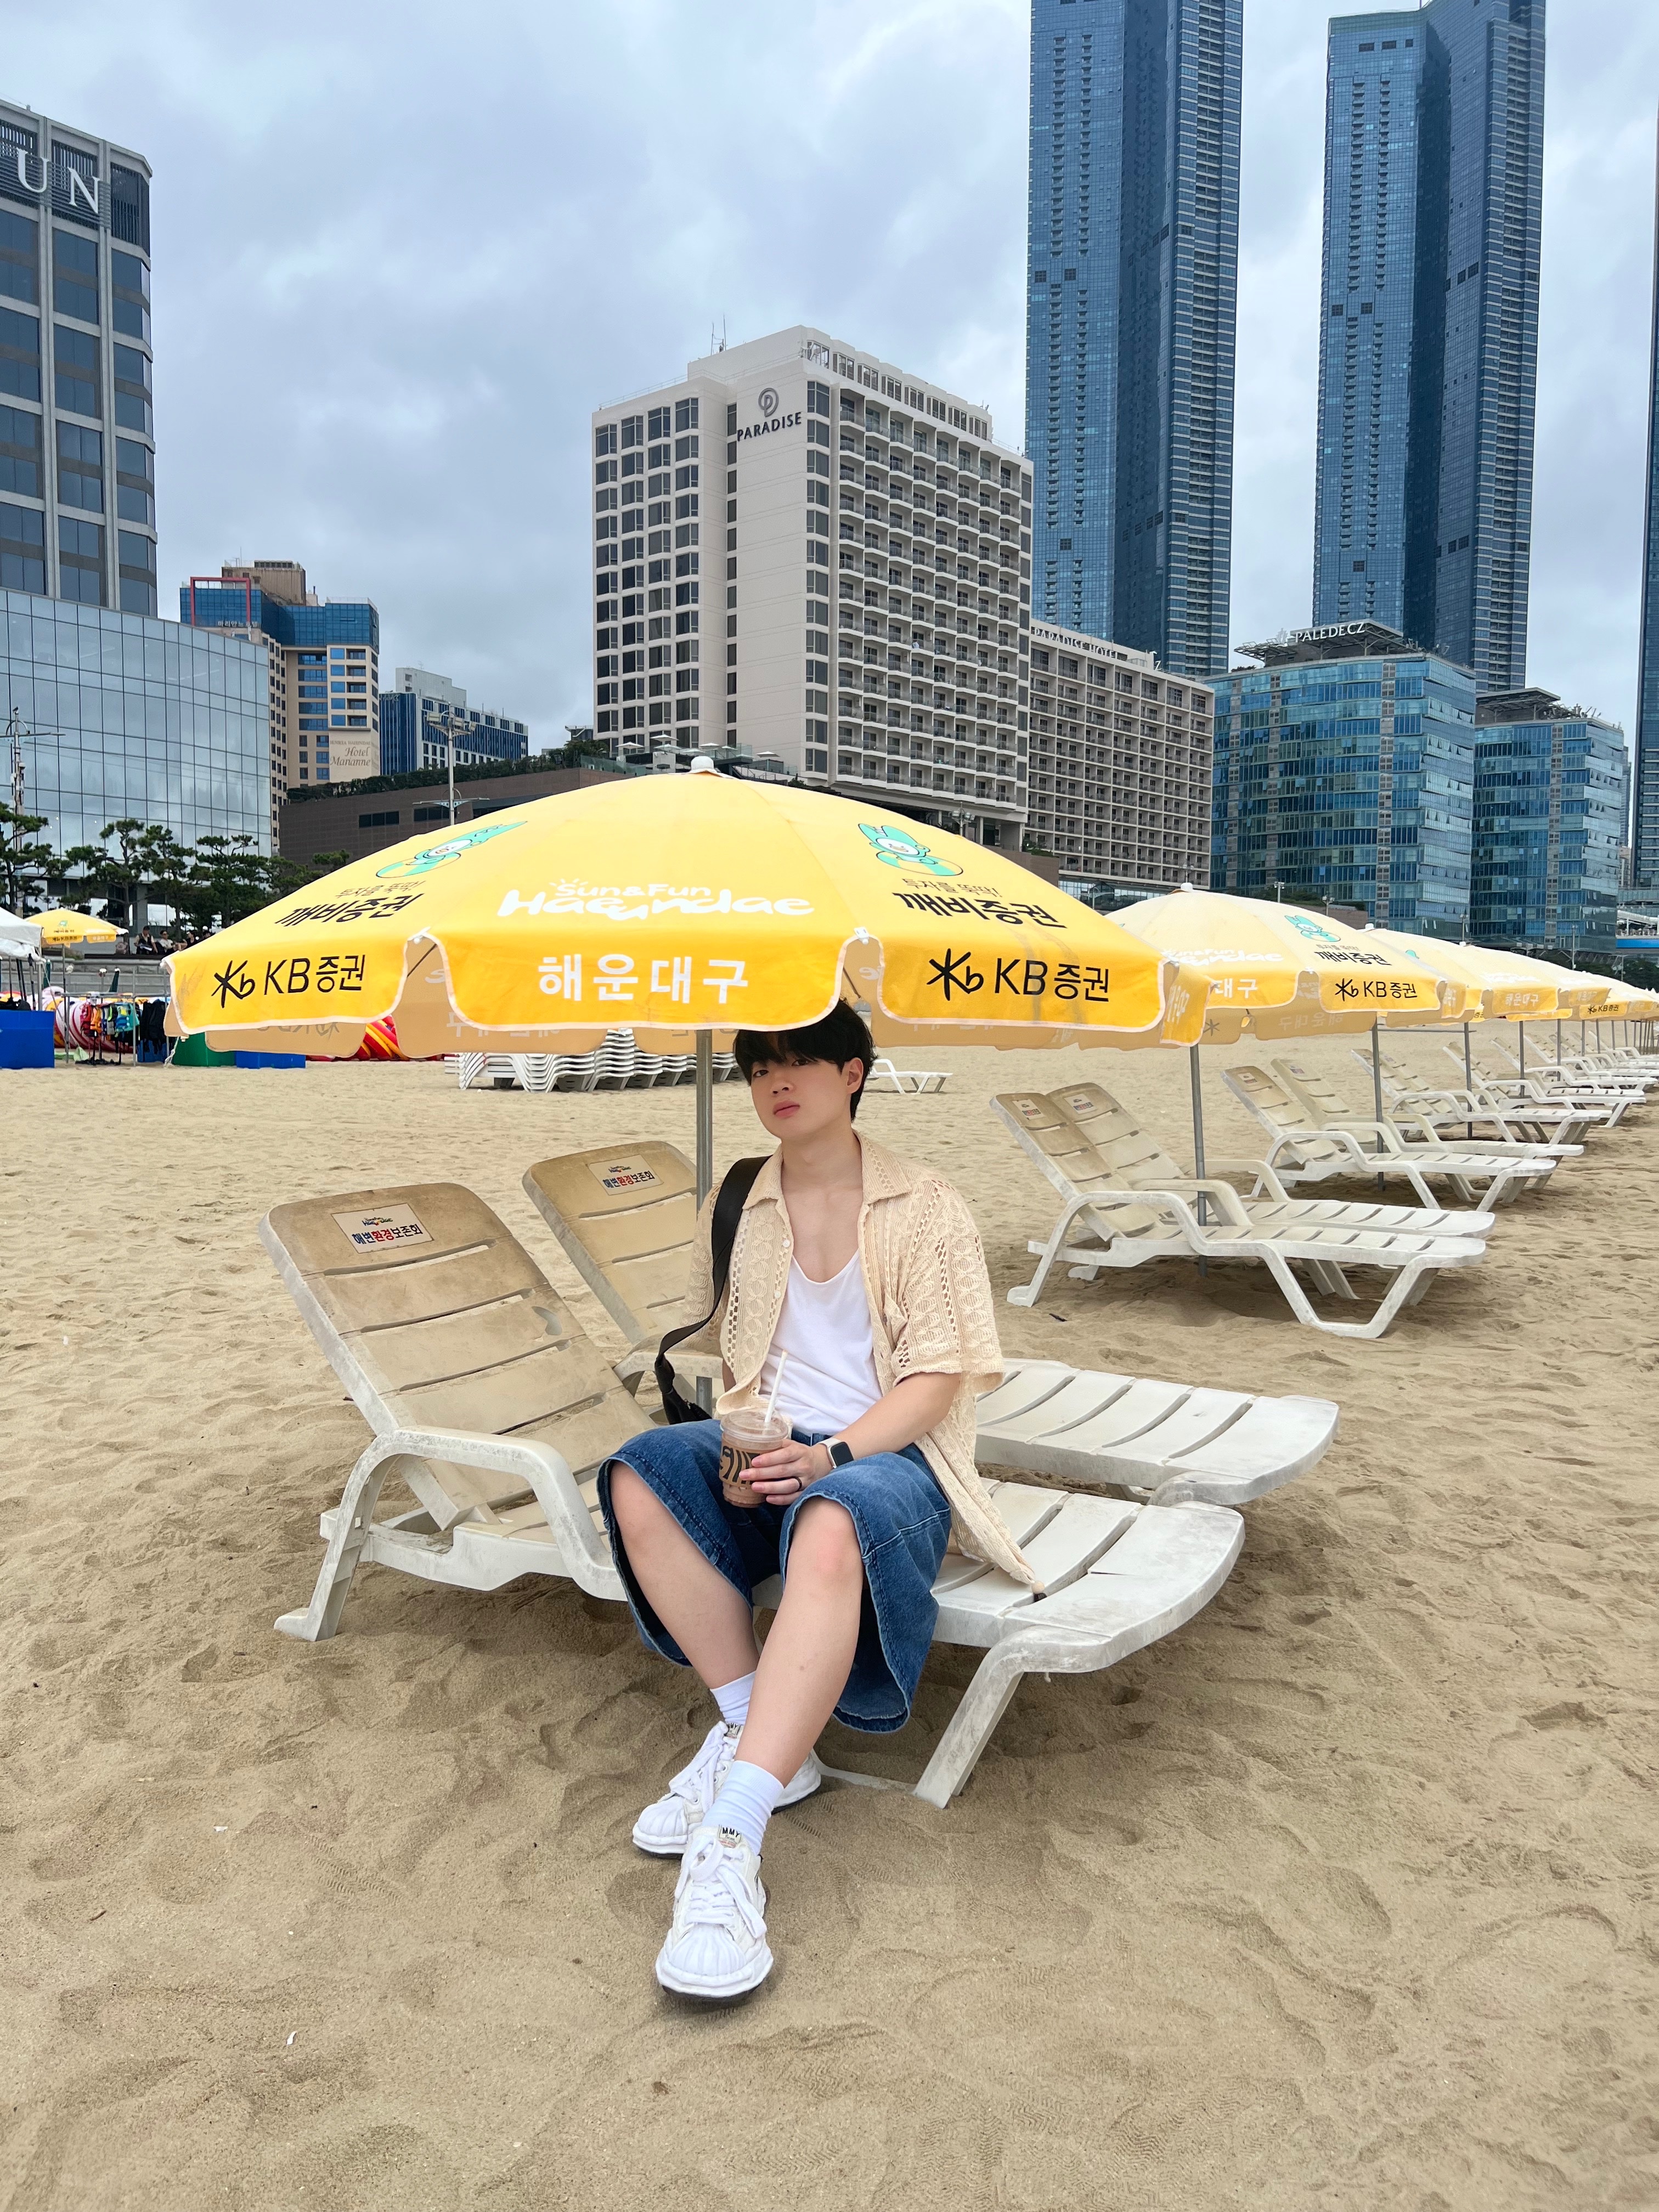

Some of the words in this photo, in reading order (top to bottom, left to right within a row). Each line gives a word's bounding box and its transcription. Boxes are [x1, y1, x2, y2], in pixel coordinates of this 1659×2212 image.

[737, 411, 802, 442] PARADISE
[1034, 627, 1086, 650] PARADISE
[1088, 643, 1118, 659] HOTEL
[330, 756, 371, 766] Marianne
[345, 746, 370, 757] Hotel
[554, 882, 712, 898] Sun&Fun
[274, 893, 425, 927] 깨비증권
[496, 889, 815, 921] Haeundae
[891, 892, 1068, 928] 깨비증권
[1314, 951, 1392, 966] 깨비증권
[538, 953, 748, 1005] 해운대구
[352, 1223, 424, 1245] 해변환경보존회
[722, 1827, 741, 1838] MMY
